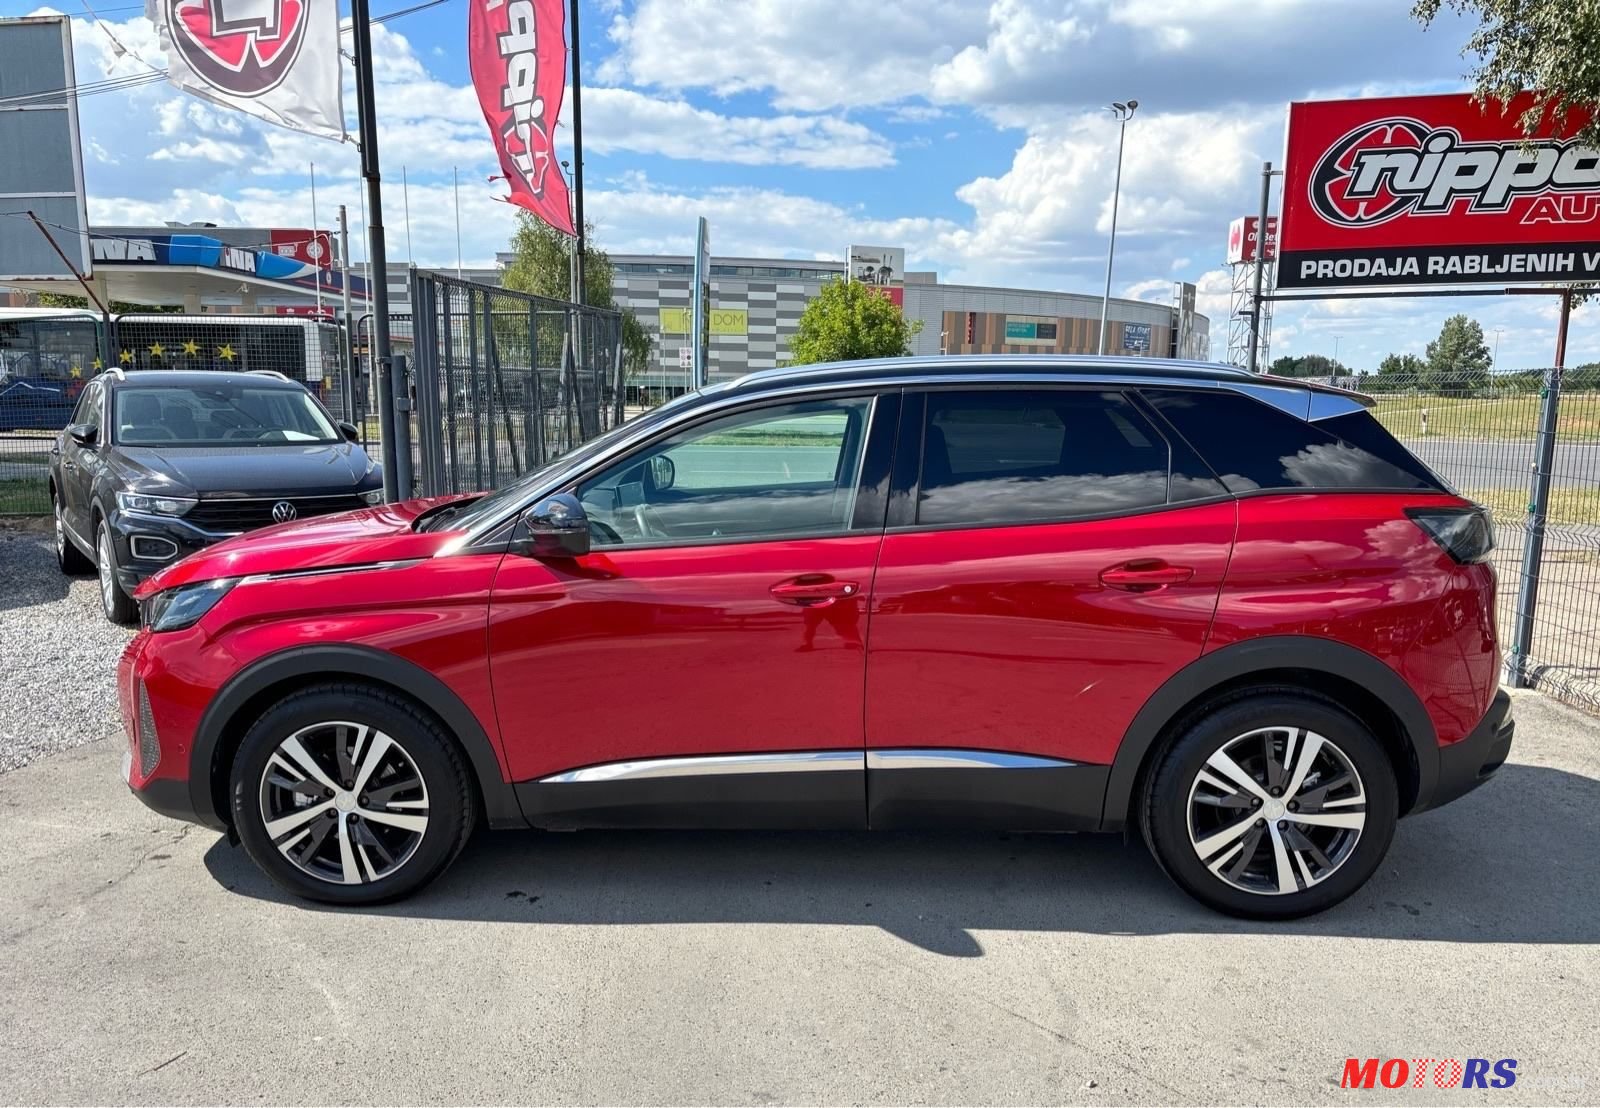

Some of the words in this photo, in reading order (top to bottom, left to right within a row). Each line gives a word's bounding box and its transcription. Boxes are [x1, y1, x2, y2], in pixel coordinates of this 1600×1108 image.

[1520, 194, 1600, 224] AU
[91, 239, 157, 260] NA
[224, 247, 256, 272] INA
[1300, 256, 1420, 279] PRODAJA
[1427, 253, 1574, 275] RABLJENIH
[713, 313, 743, 326] DOM
